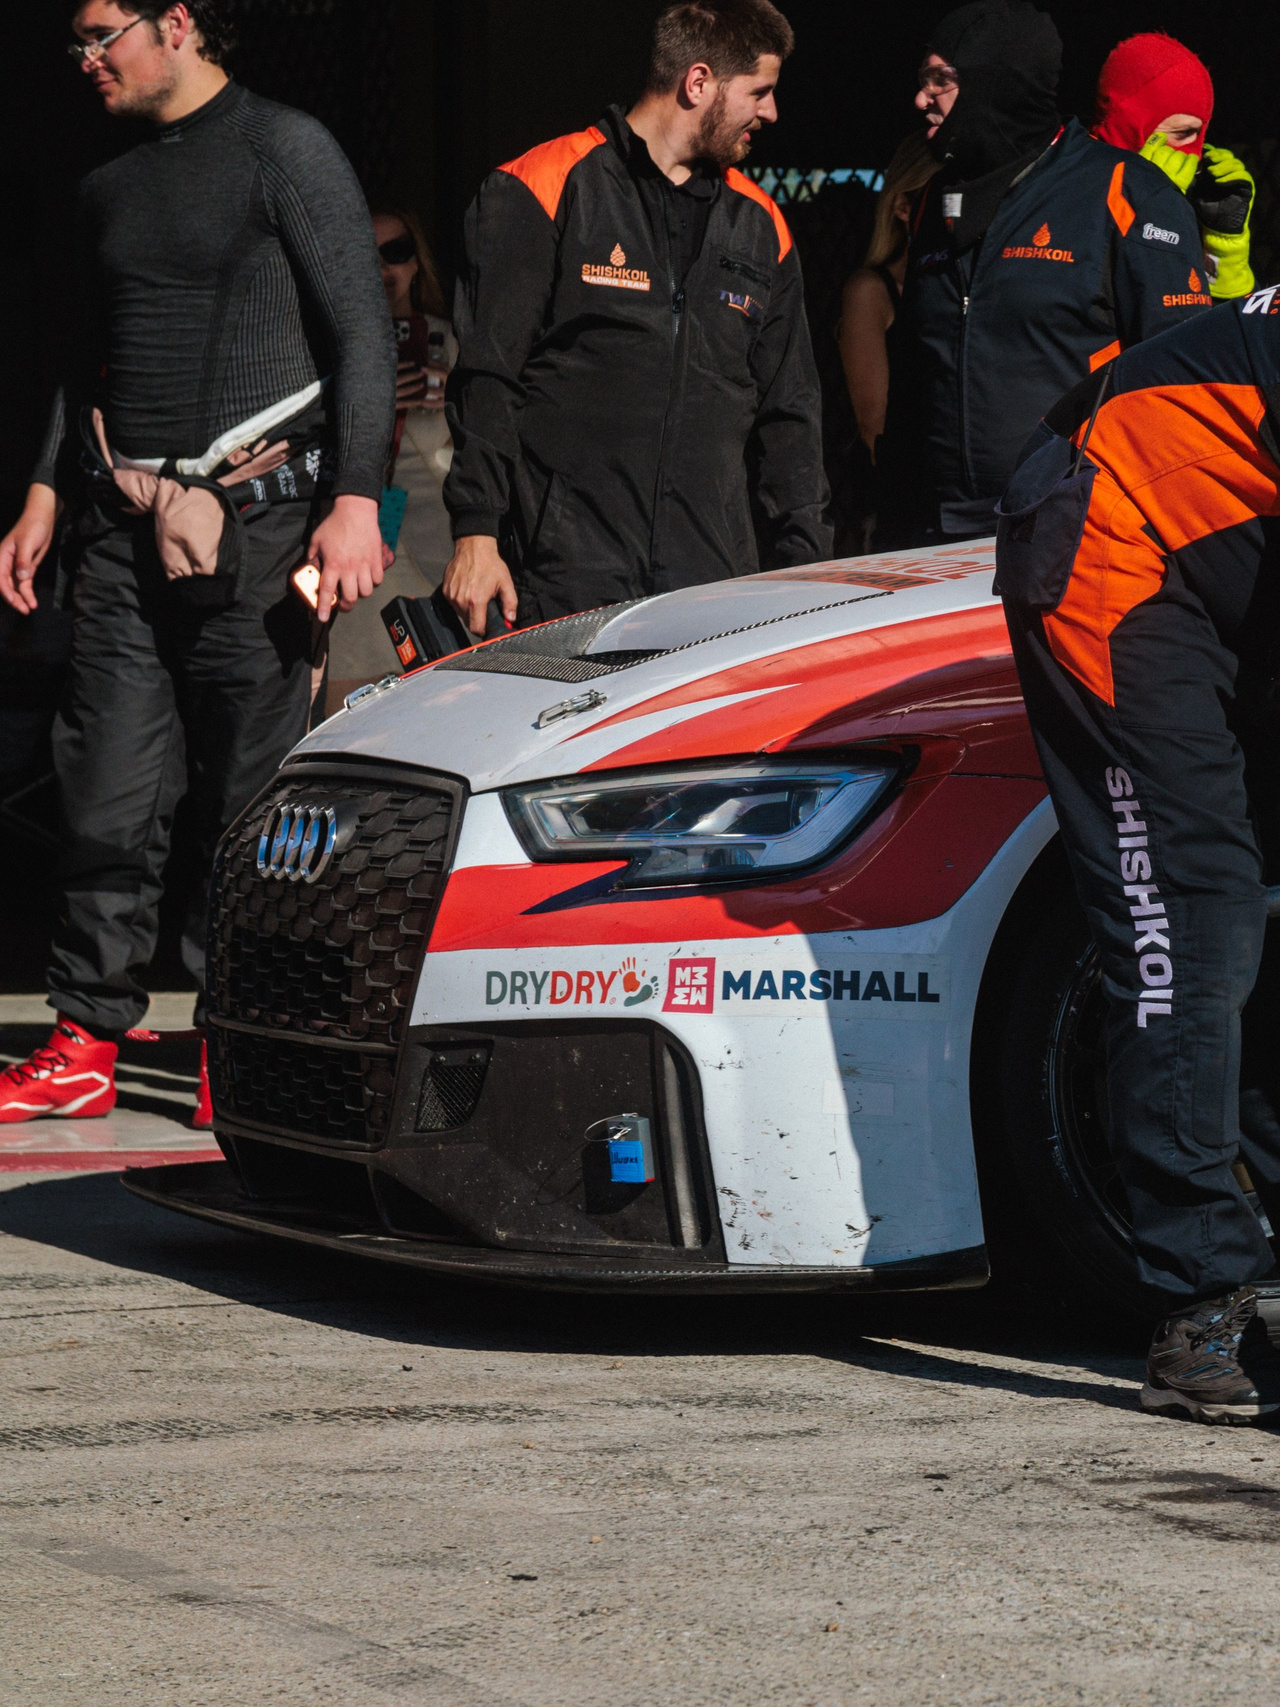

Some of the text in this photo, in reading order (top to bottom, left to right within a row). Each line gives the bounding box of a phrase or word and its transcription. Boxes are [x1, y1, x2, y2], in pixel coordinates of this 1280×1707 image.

[1143, 223, 1180, 245] freem
[1001, 247, 1075, 263] SHISHKOIL
[582, 264, 650, 282] SHISHKOIL
[583, 275, 648, 288] RACING TEAM
[1105, 766, 1173, 1028] SHISHKOIL
[722, 970, 940, 1003] MARSHALL
